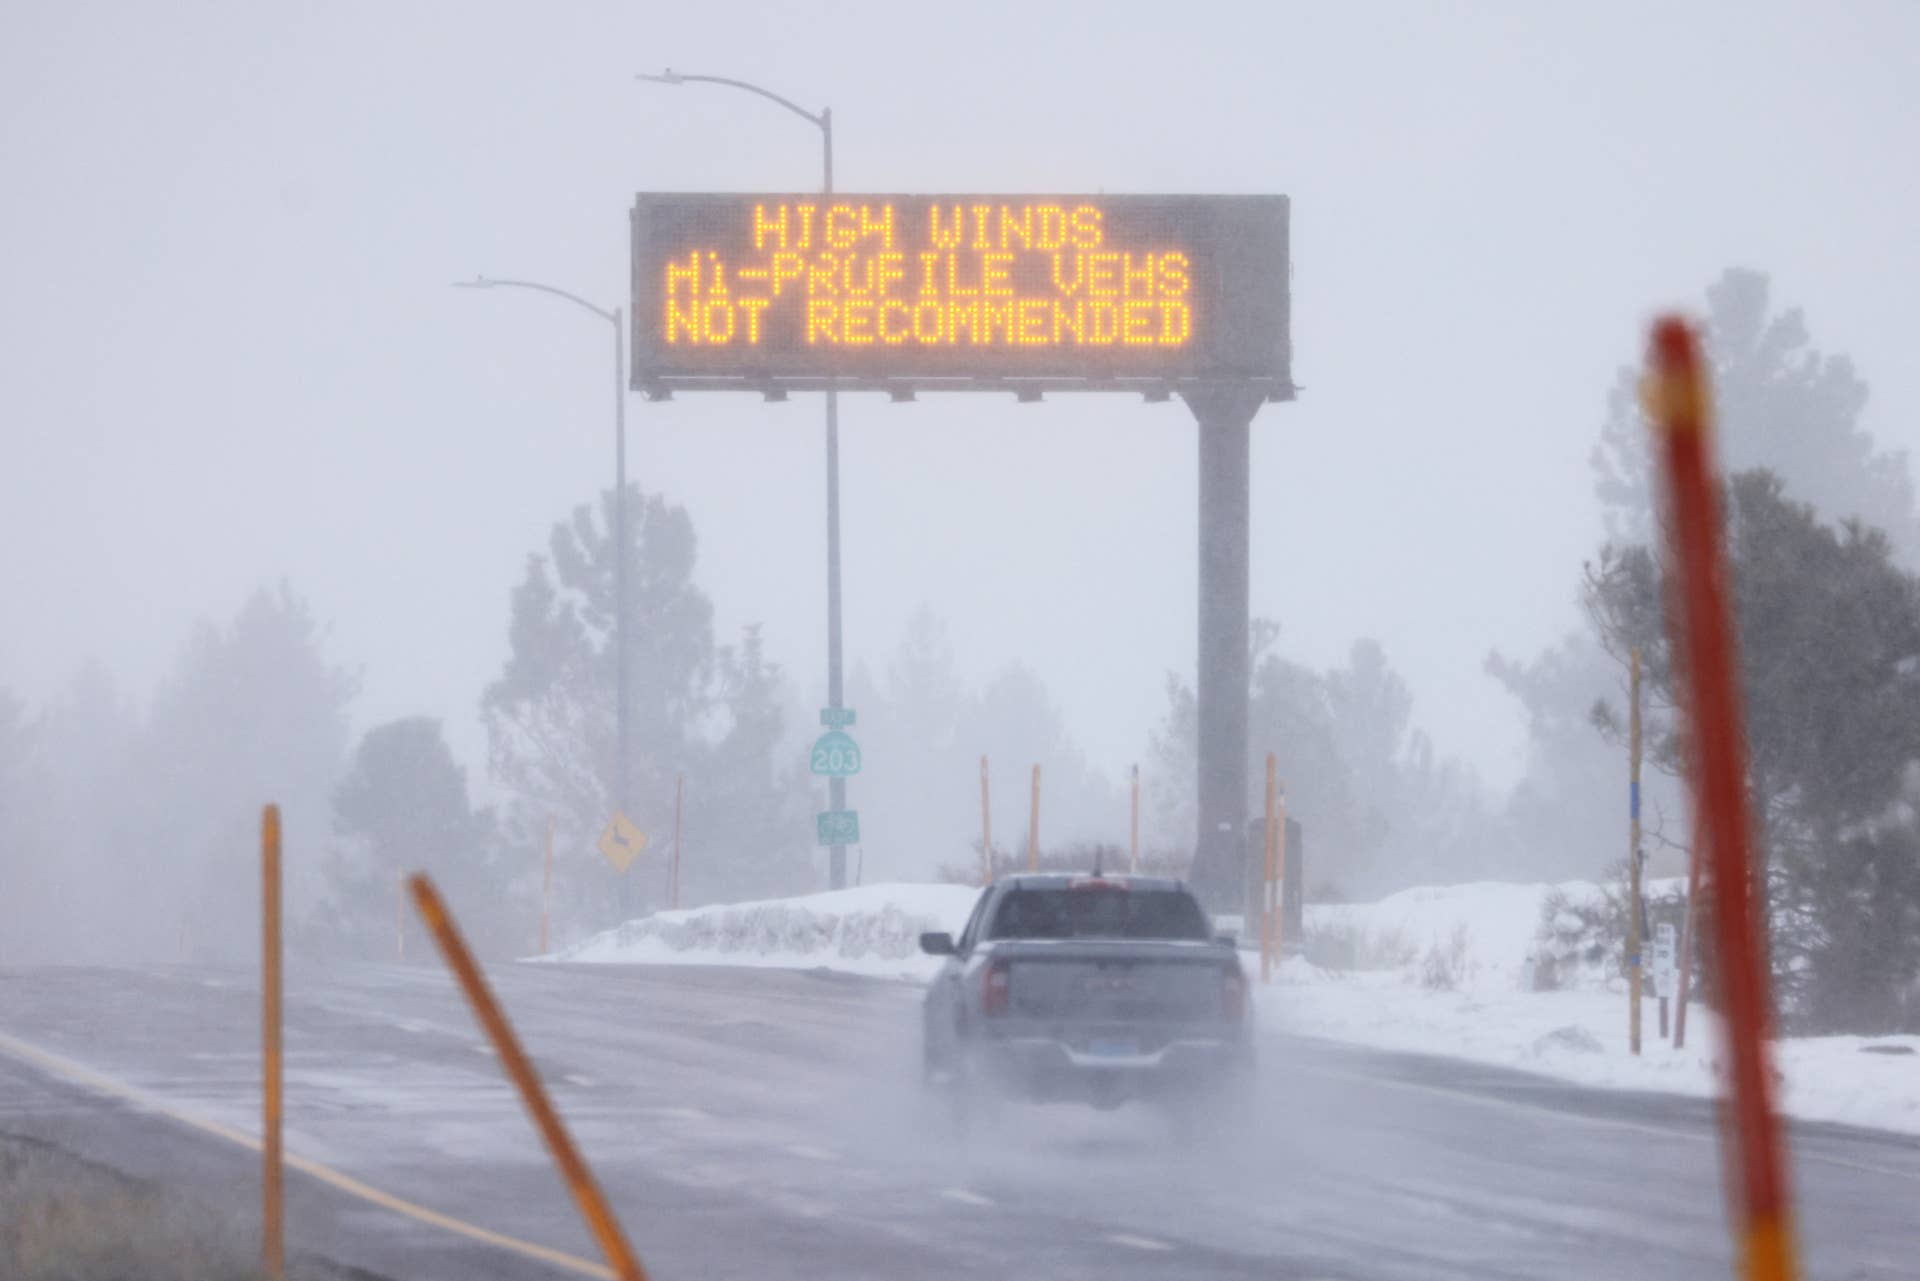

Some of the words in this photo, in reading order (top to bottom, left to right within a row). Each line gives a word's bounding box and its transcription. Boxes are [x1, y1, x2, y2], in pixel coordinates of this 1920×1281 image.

[754, 205, 894, 249] HIGH
[930, 205, 1103, 250] WINDS
[1052, 252, 1190, 297] VEHS
[666, 299, 771, 344] NOT
[807, 299, 1191, 345] RECOMMENDED
[813, 749, 859, 771] 203
